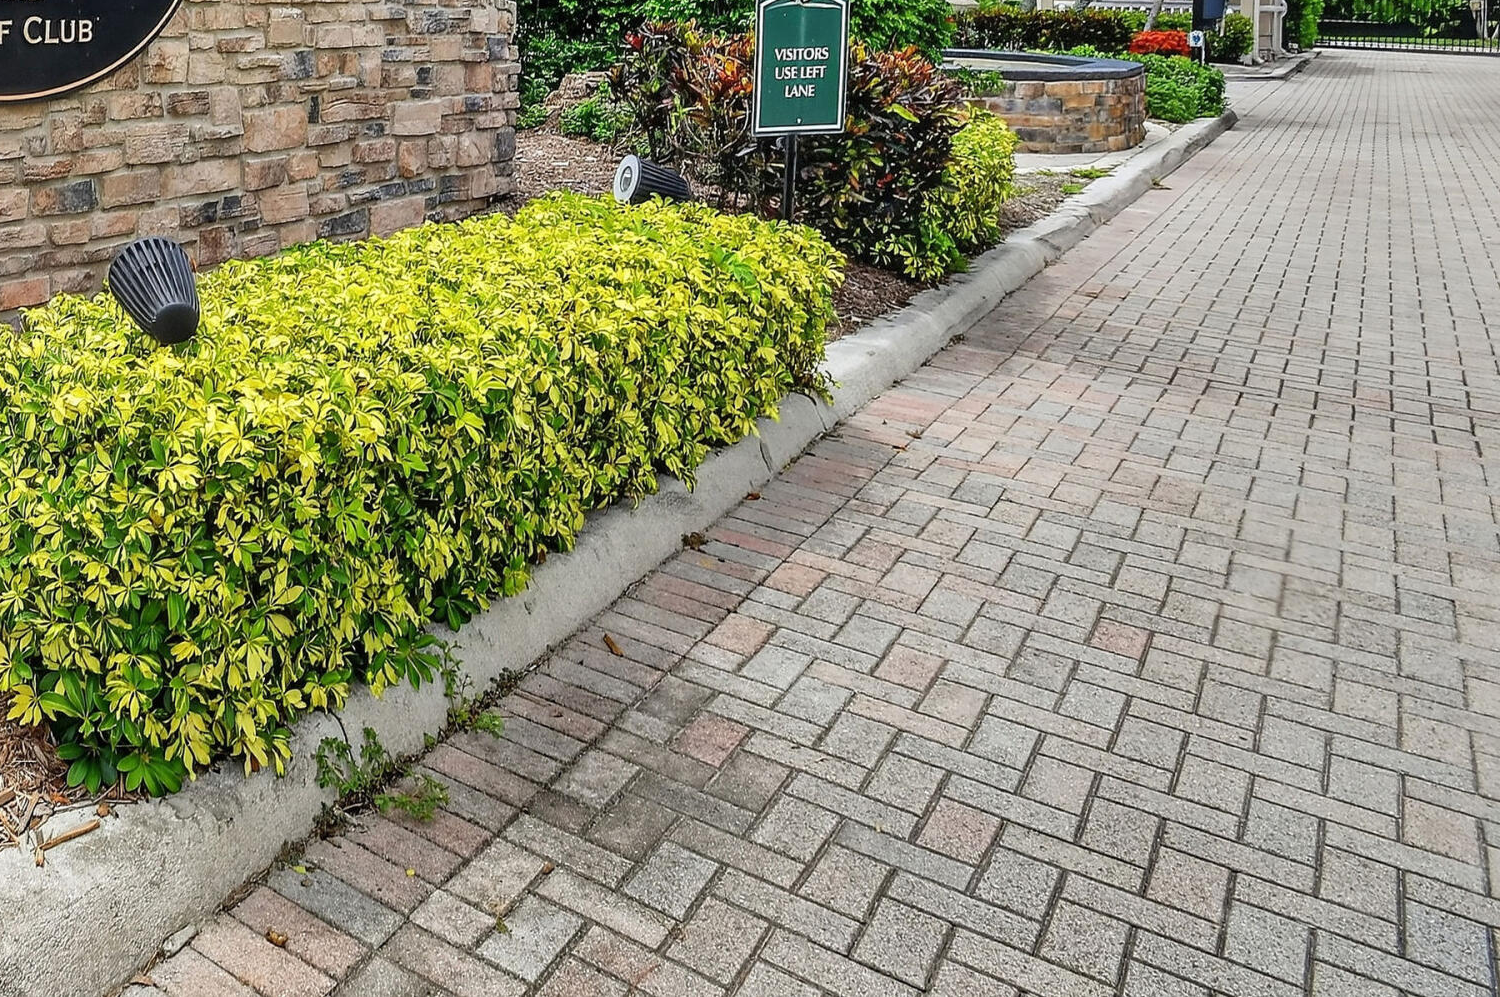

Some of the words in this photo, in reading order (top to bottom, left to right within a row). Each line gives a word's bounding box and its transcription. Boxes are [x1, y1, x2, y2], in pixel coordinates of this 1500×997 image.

[23, 16, 93, 44] CLUB
[775, 47, 829, 61] VISITORS
[775, 67, 797, 79] USE
[800, 66, 826, 79] LEFT
[785, 85, 815, 98] LANE
